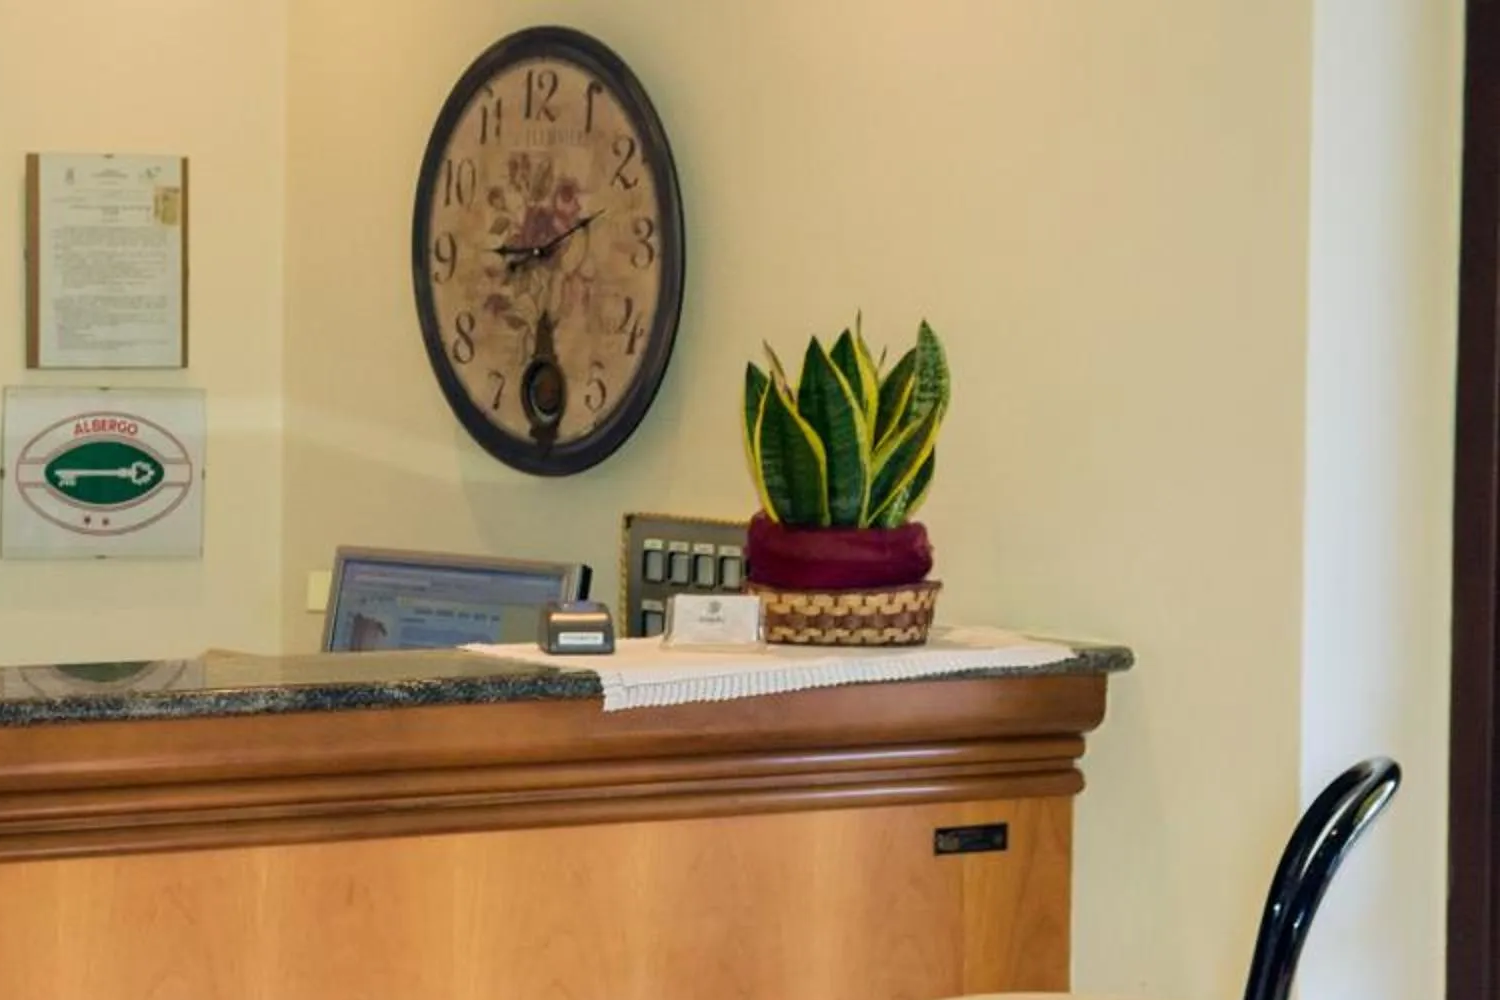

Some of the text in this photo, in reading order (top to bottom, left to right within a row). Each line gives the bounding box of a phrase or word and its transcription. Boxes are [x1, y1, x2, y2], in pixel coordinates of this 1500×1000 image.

[479, 86, 502, 145] 11
[524, 68, 559, 123] 12
[443, 158, 476, 208] 10
[609, 135, 639, 190] 2
[434, 232, 457, 283] 9
[631, 216, 655, 269] 3
[453, 311, 476, 365] 8
[615, 296, 644, 354] 4
[488, 370, 506, 411] 7
[585, 360, 607, 412] 5
[73, 418, 138, 436] ALBERGO
